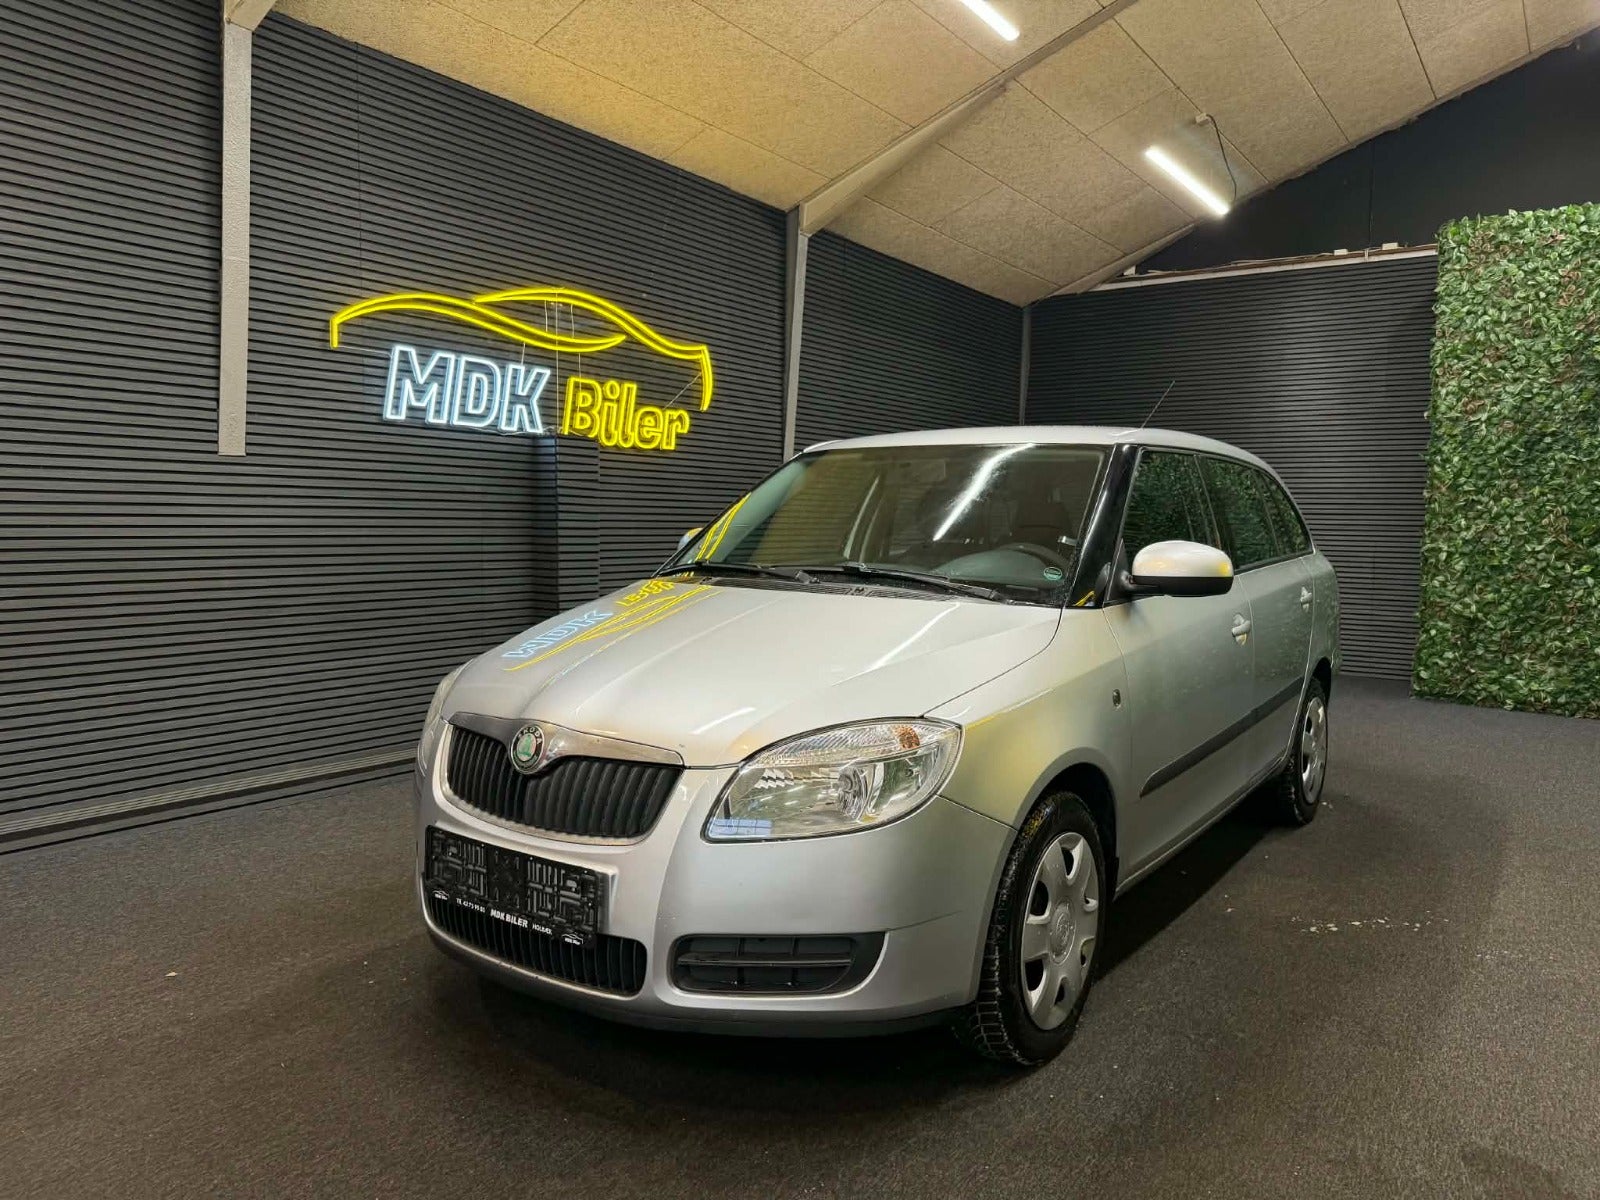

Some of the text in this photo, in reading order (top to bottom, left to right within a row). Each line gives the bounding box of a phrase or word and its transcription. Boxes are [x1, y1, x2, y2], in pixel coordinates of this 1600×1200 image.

[383, 344, 690, 451] MDK Biler
[505, 913, 528, 928] BILER
